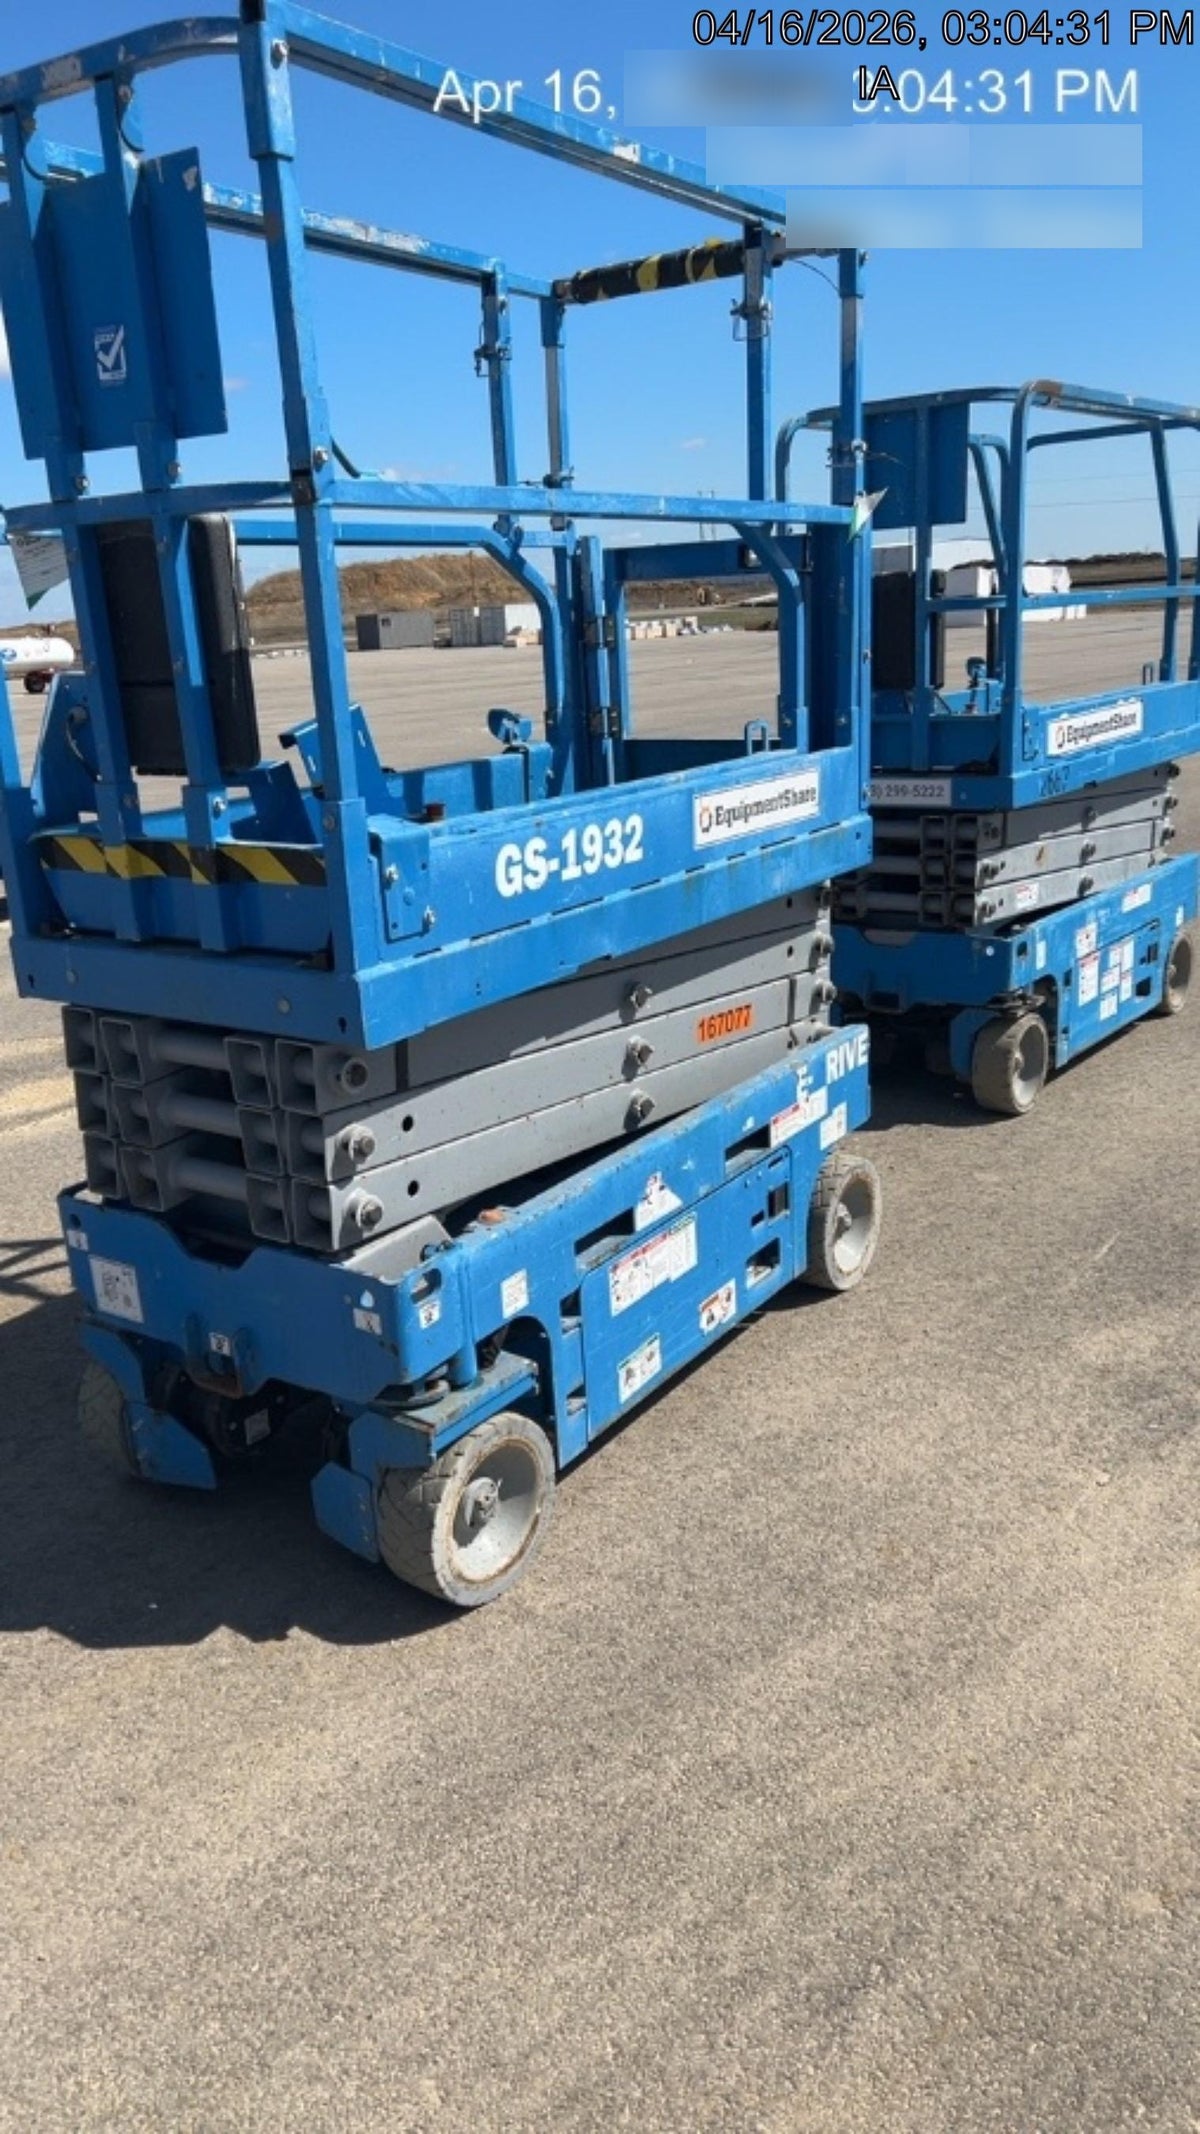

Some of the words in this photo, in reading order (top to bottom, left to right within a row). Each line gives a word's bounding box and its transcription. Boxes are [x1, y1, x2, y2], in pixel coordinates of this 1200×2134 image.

[1066, 712, 1137, 745] EquipmentShare
[715, 786, 817, 828] EquipmentShare
[495, 813, 643, 897] GS-1932
[699, 1003, 752, 1042] 167077
